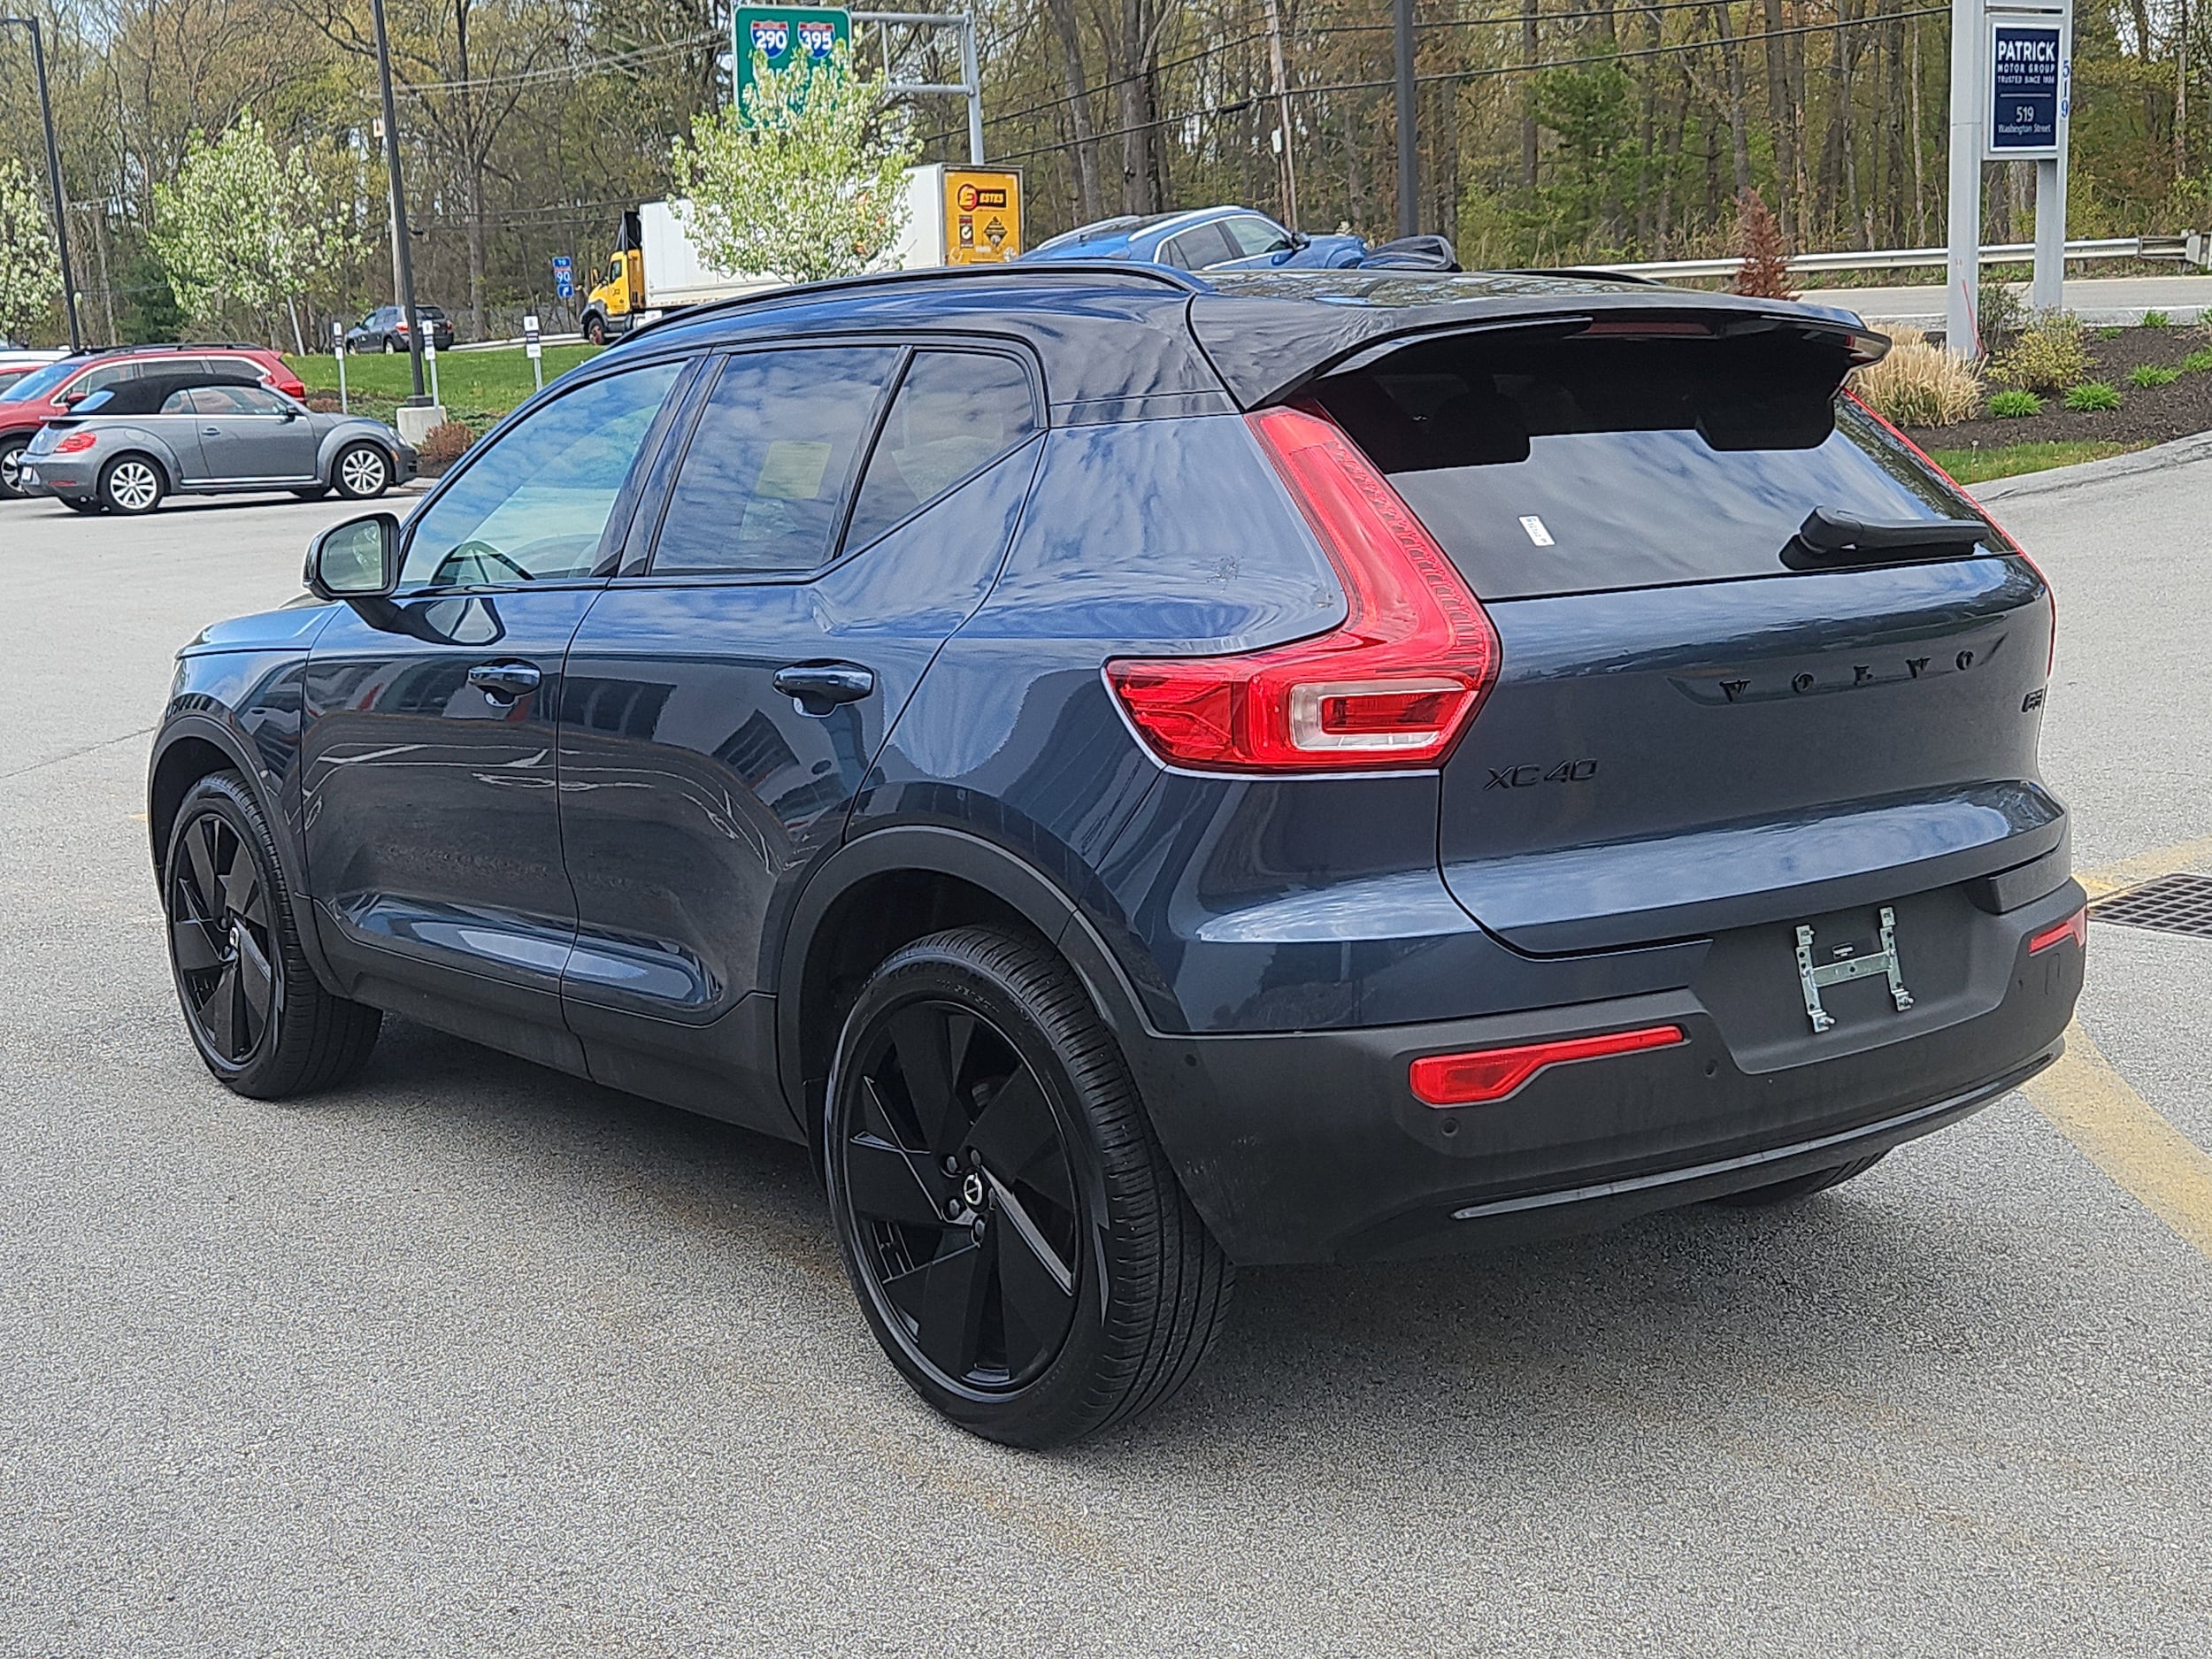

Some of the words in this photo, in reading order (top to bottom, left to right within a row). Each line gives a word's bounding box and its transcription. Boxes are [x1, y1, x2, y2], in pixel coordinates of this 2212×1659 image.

[756, 30, 787, 50] 290
[802, 30, 832, 50] 395
[1997, 41, 2055, 62] PATRICK
[1997, 64, 2025, 73] MOTOR
[2028, 64, 2055, 73] GROUP
[1998, 75, 2022, 84] TRUSTED
[2024, 75, 2041, 84] SINCE
[2016, 105, 2034, 123] 519
[1998, 123, 2032, 135] Washington
[2033, 123, 2051, 133] Street
[979, 192, 1004, 204] ESTES
[557, 272, 571, 283] 90
[1719, 649, 1974, 703] VOLVO
